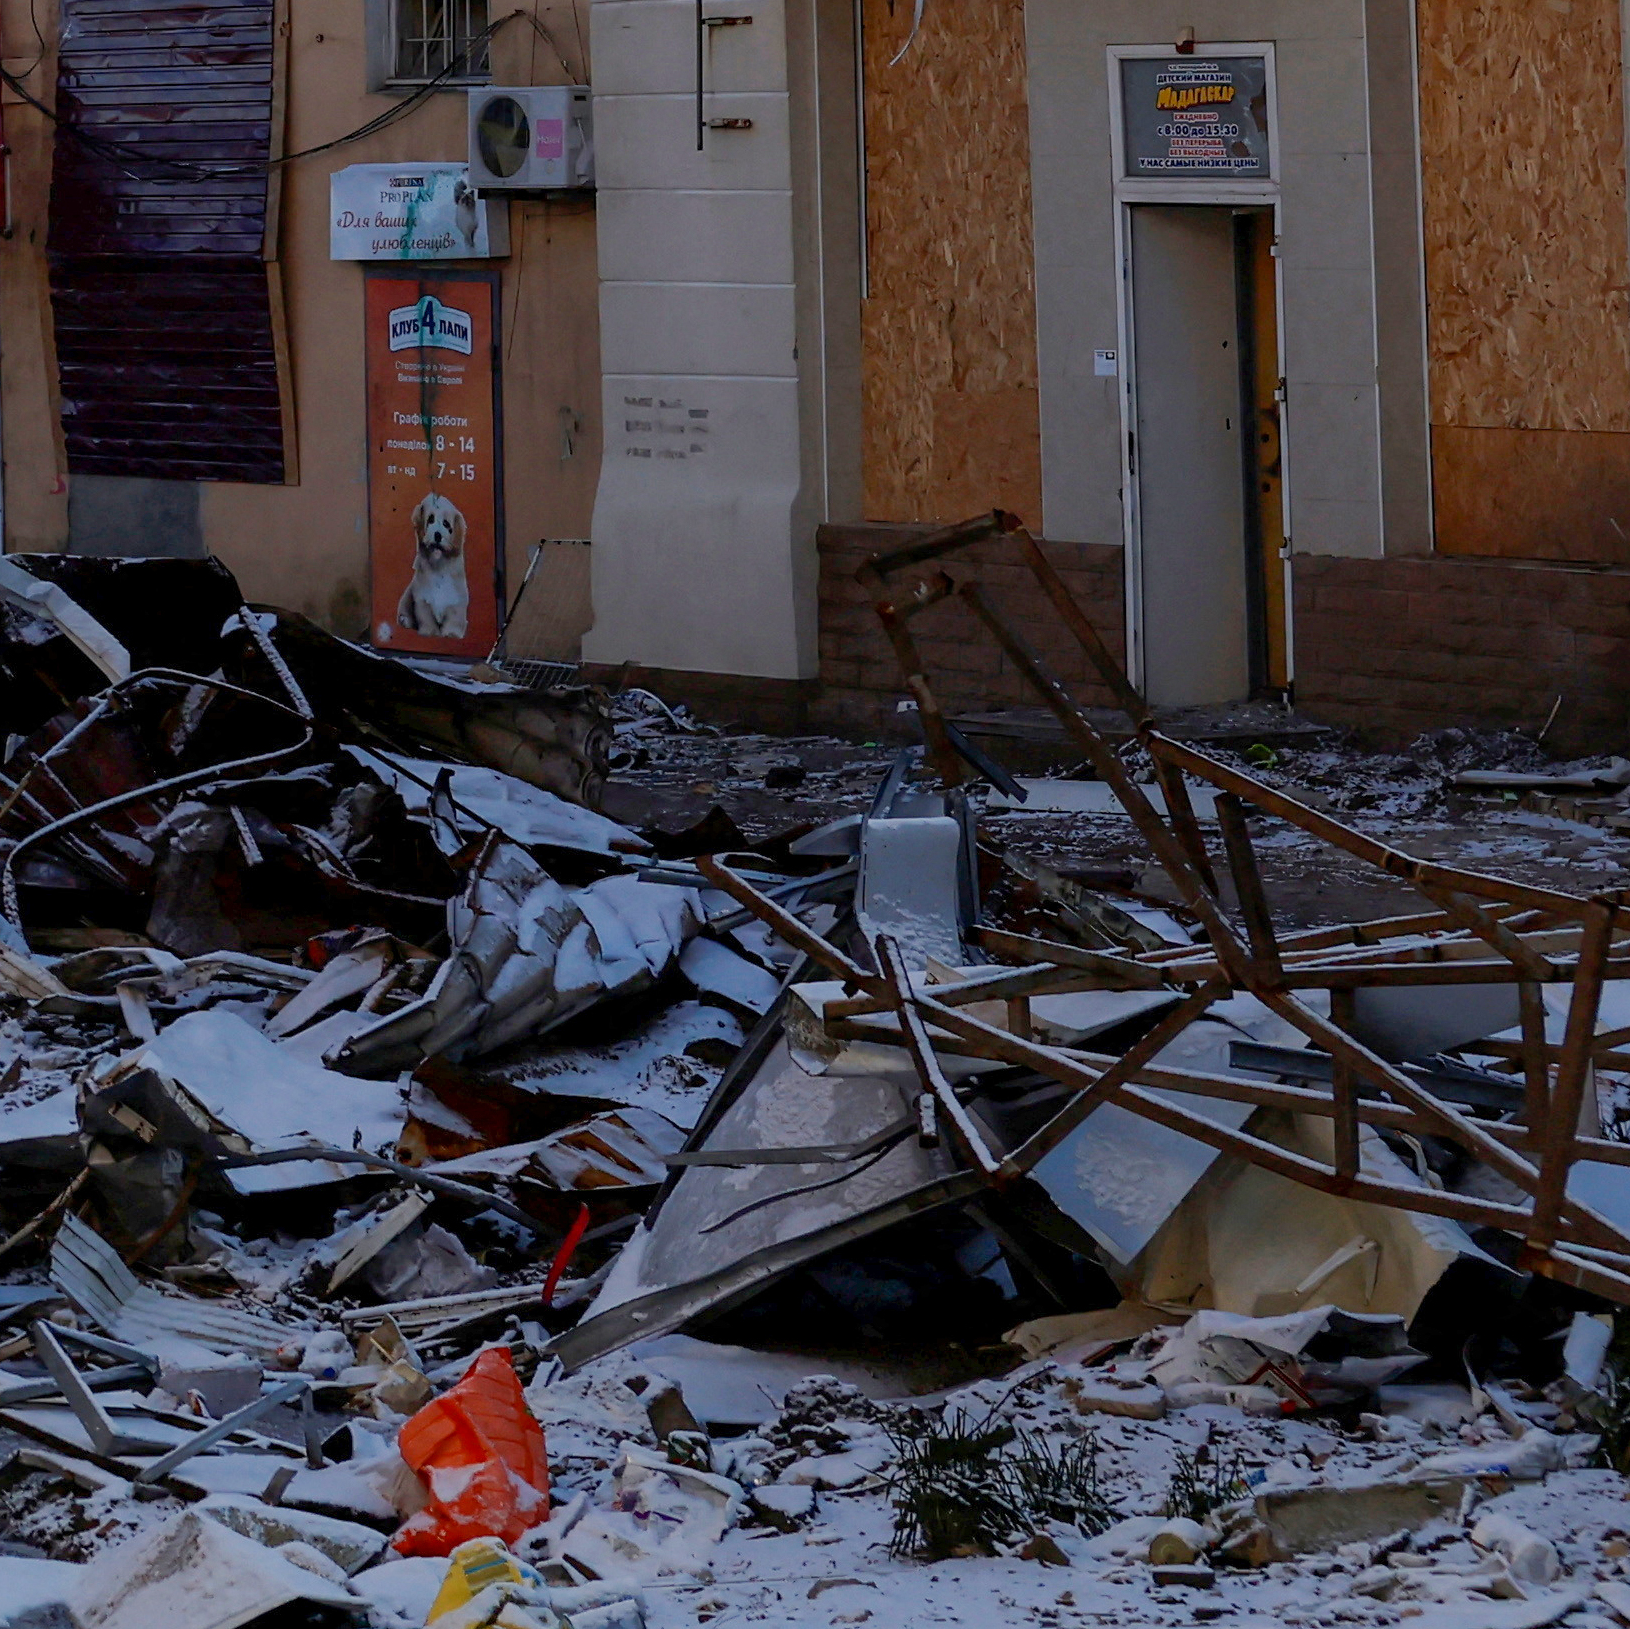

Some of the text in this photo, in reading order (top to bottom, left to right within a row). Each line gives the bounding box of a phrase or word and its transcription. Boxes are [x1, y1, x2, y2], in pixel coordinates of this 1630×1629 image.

[1158, 73, 1193, 83] ДЕТСКИЙ
[1174, 113, 1218, 121] ЕЖЕДНЕВНО
[1164, 125, 1189, 135] 8.00
[1191, 128, 1205, 136] до
[1183, 149, 1226, 157] ВЫХОДНЫХ
[1148, 158, 1164, 167] НАС
[1165, 158, 1195, 167] САМЫЕ
[1197, 158, 1232, 167] НИЗКИЕ
[1234, 158, 1258, 168] ЦЕНЫ
[336, 211, 370, 228] «Для
[372, 231, 456, 255] улюбленців»
[391, 300, 469, 341] КЛУБ 4 ЛАПИ
[431, 414, 468, 427] роботи
[436, 435, 444, 451] 8
[459, 436, 475, 453] 14
[437, 462, 446, 479] 7
[459, 464, 475, 481] 15
